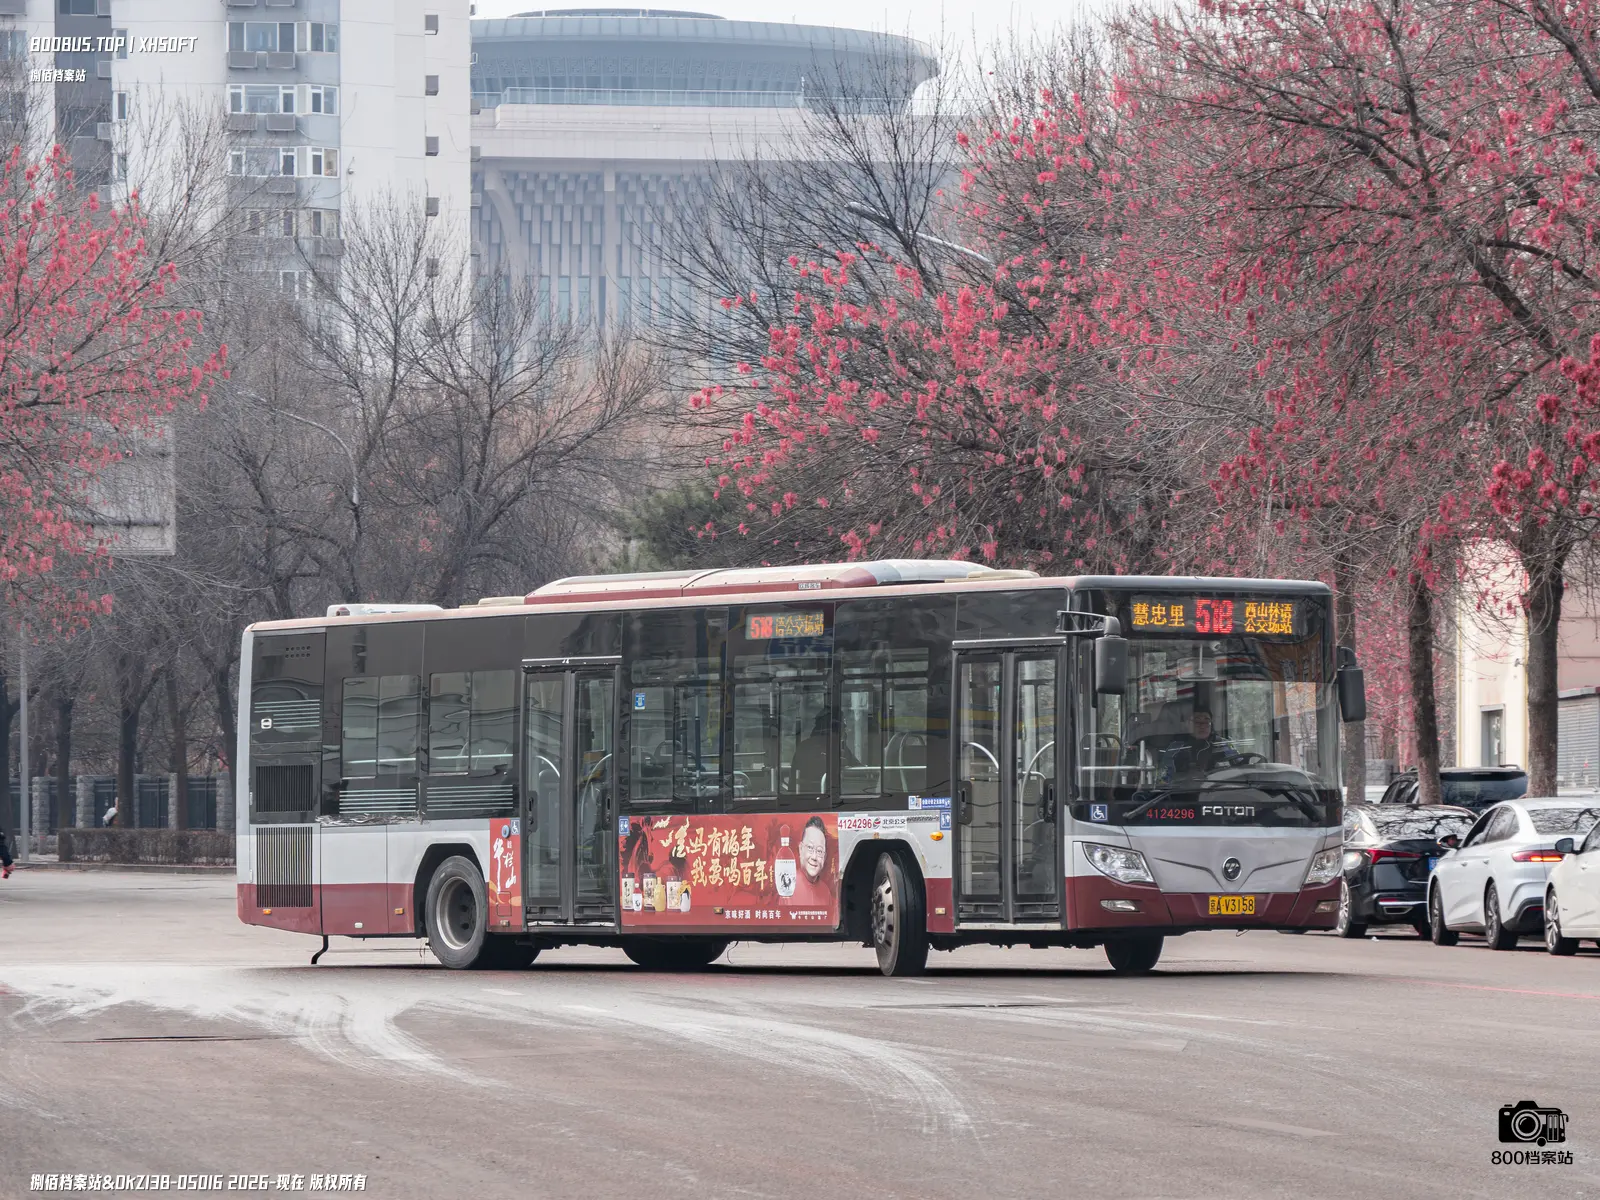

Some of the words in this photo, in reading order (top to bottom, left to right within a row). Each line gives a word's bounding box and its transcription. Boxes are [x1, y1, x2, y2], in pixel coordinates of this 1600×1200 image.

[1132, 603, 1186, 627] 慧忠里
[1195, 599, 1235, 634] 518
[1245, 602, 1293, 618] 西山林语
[750, 616, 773, 639] 518
[1244, 617, 1293, 634] 公交场站
[1146, 808, 1195, 819] 4124296
[1202, 806, 1256, 817] FOTON
[838, 819, 872, 829] 4124296
[755, 909, 782, 920] 时尚百年
